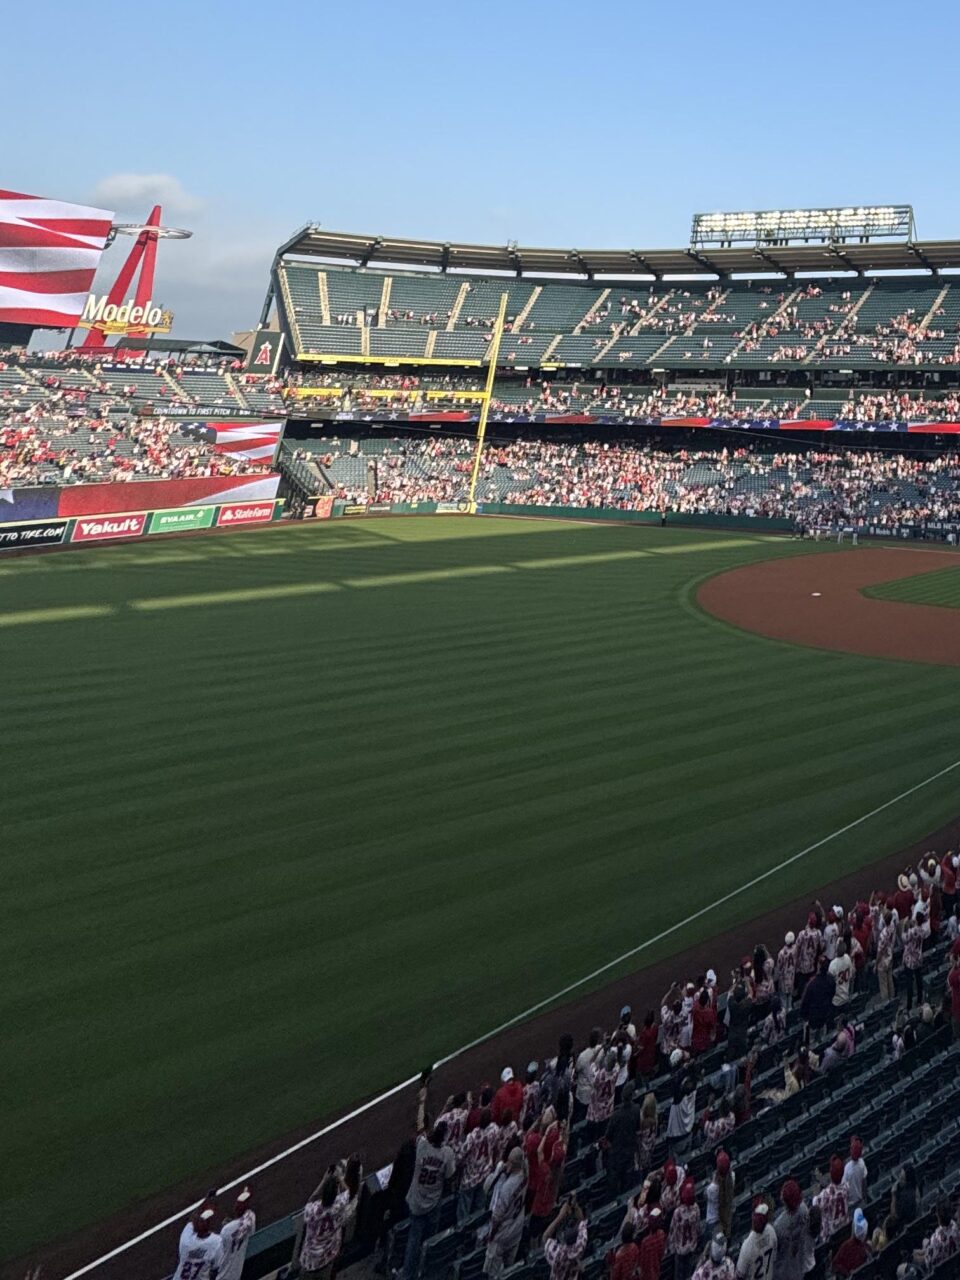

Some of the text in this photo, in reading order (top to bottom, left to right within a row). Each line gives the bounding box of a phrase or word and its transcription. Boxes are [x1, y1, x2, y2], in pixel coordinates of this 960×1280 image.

[81, 294, 162, 326] Modelo
[153, 407, 187, 415] COUNTDOWN
[80, 519, 140, 535] Yakult
[838, 968, 851, 985] 30
[180, 1261, 206, 1280] 27
[754, 1248, 774, 1280] 27
